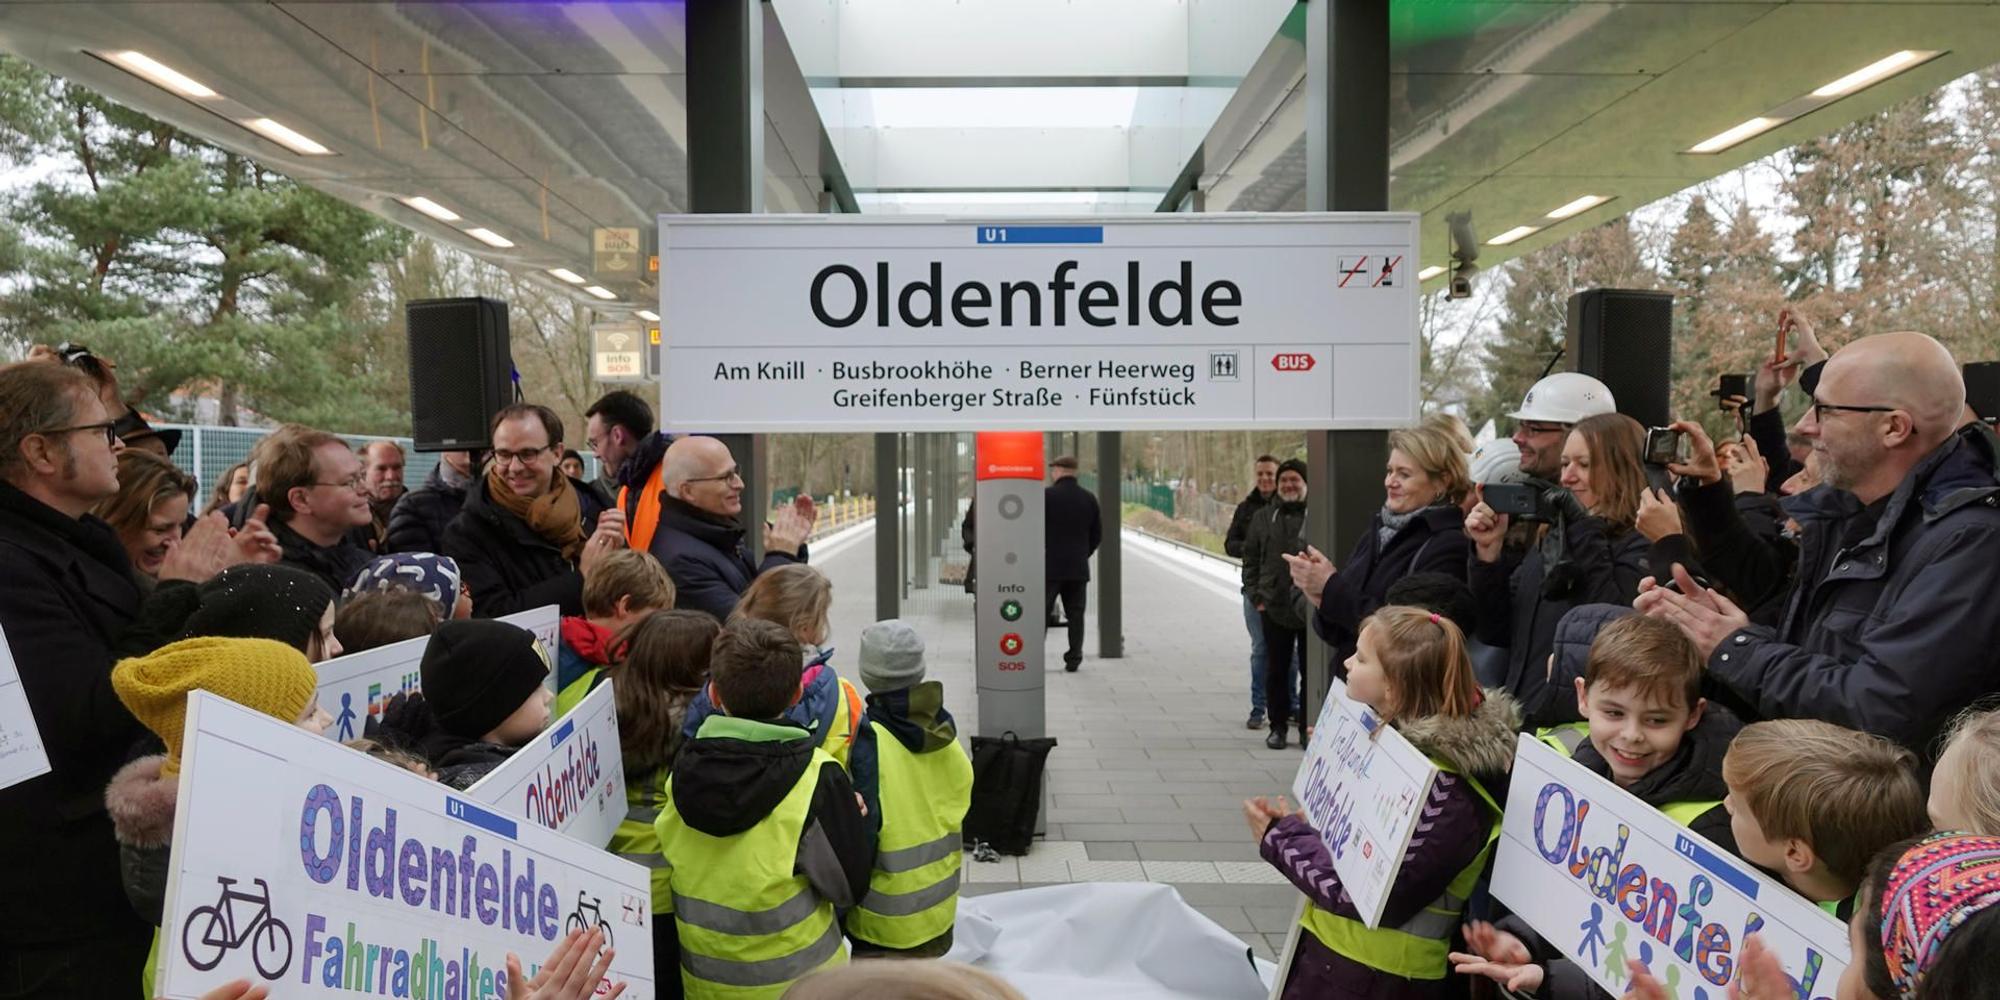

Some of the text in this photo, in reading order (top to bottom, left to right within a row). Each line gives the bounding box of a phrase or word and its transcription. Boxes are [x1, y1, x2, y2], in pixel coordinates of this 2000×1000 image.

[985, 229, 1007, 241] U1
[809, 260, 1243, 329] Oldenfelde
[713, 359, 1195, 384] Am Knill Busbrookhöhe Berner Heerweg
[1278, 355, 1309, 369] BUS
[833, 386, 1196, 412] Greifenberger Straße Fünfstück
[997, 583, 1026, 593] Info
[998, 661, 1026, 671] SOS
[526, 727, 600, 830] Oldenfelde
[450, 800, 465, 819] U1
[1303, 756, 1355, 860] Oldenfelde
[1679, 836, 1696, 857] U1
[300, 783, 560, 942] Oldenfelde
